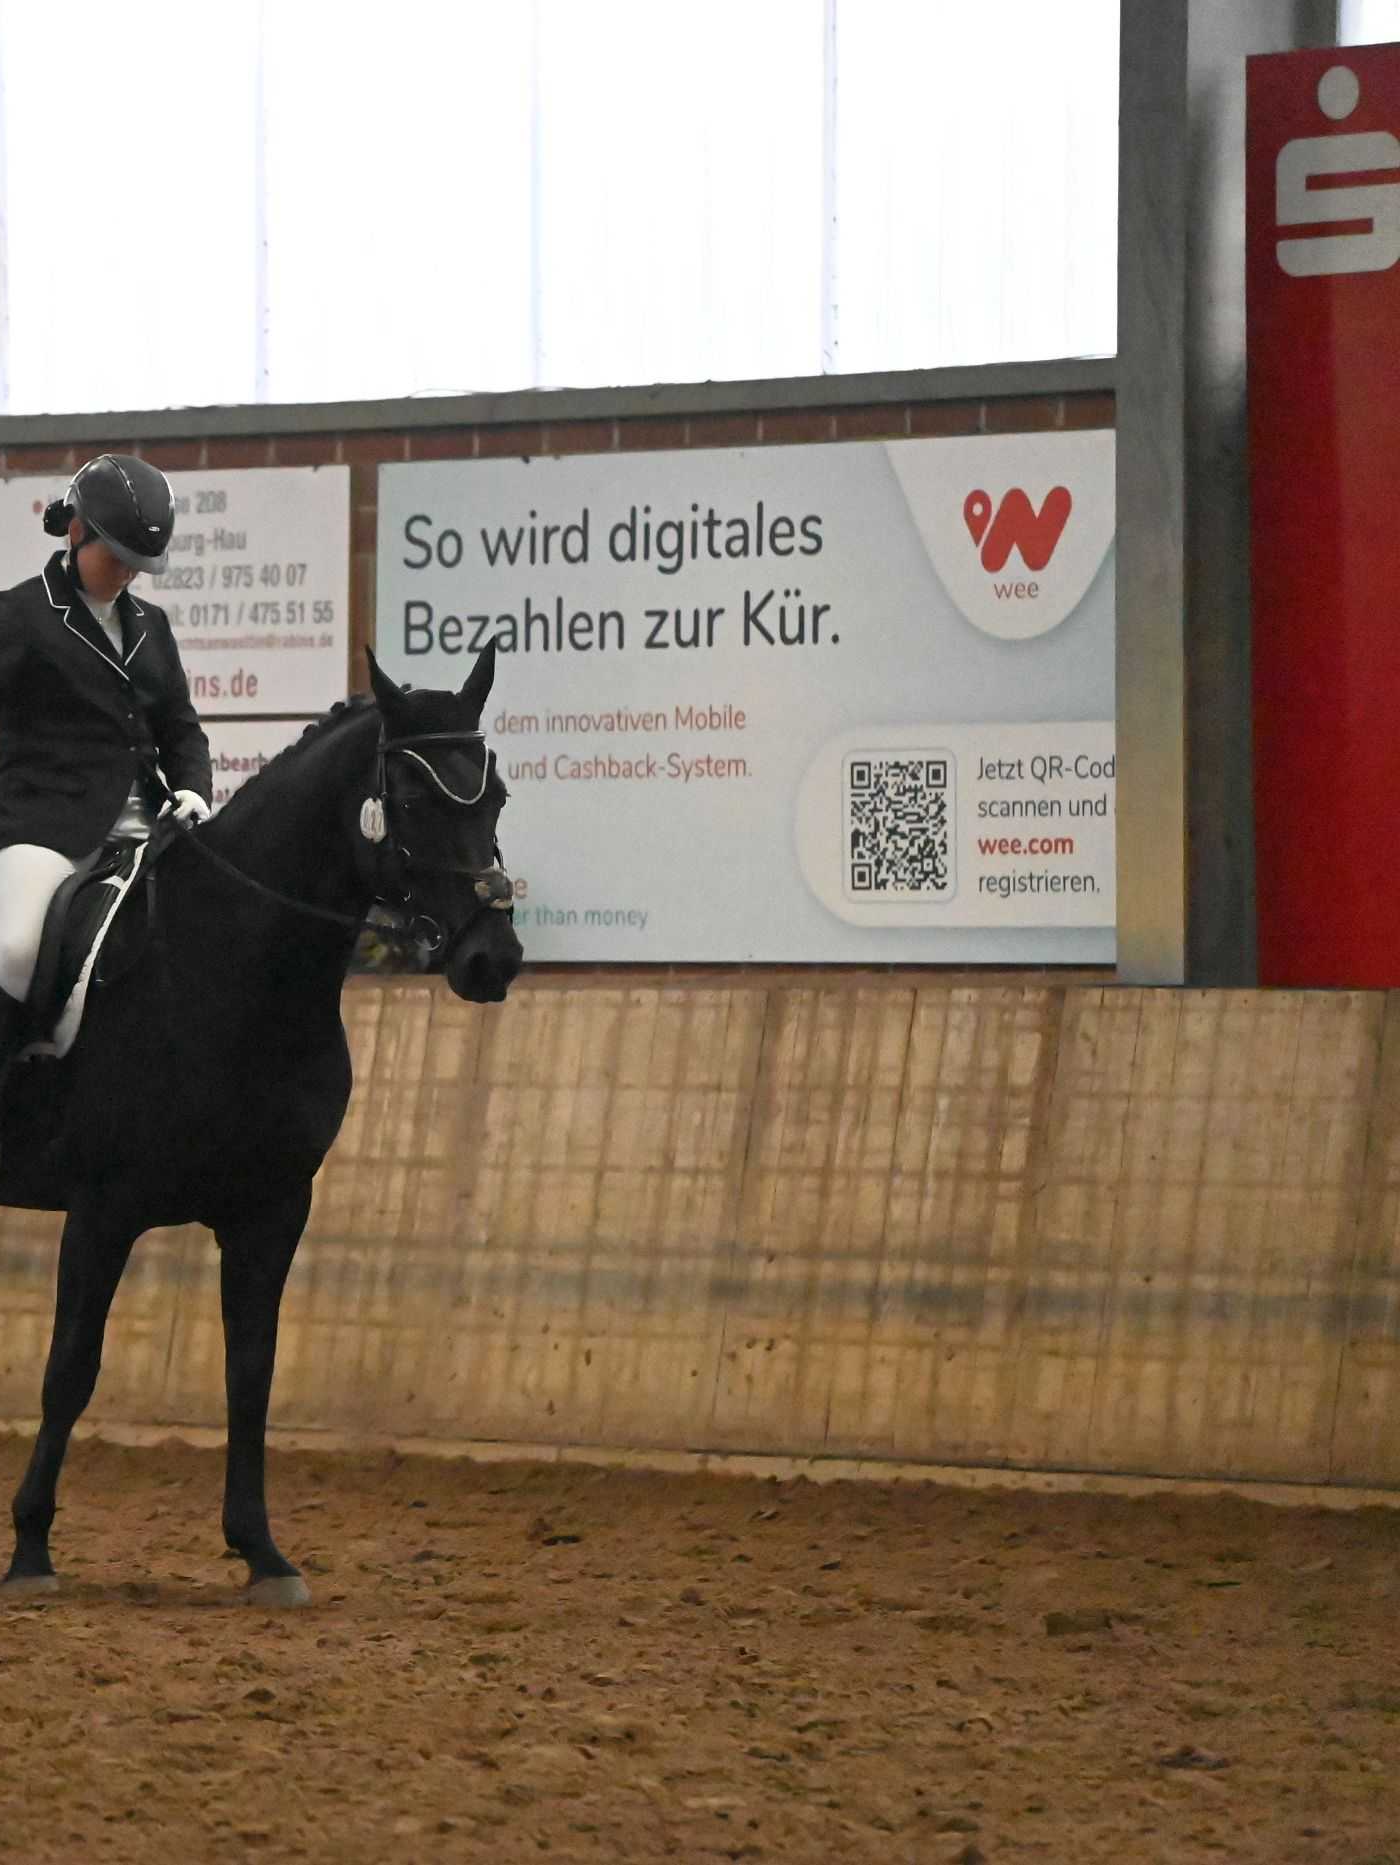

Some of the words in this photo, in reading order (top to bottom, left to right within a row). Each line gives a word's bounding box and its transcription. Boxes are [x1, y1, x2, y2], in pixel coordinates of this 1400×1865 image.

[403, 514, 463, 569] So
[481, 508, 589, 567] wird
[608, 501, 823, 575] digitales
[221, 565, 254, 590] 975
[260, 563, 281, 588] 40
[286, 562, 308, 586] 07
[993, 581, 1039, 599] wee
[189, 604, 230, 628] 0171
[249, 602, 281, 626] 475
[286, 602, 306, 624] 51
[312, 601, 334, 624] 55
[403, 597, 625, 656] Bezahlen
[644, 606, 726, 649] zur
[743, 588, 841, 647] Kür.
[494, 709, 540, 736] dem
[546, 705, 667, 735] innovativen
[674, 704, 747, 732] Mobile
[507, 754, 548, 781] und
[553, 751, 752, 783] Cashback-System.
[977, 757, 1025, 781] Jetzt
[977, 798, 1063, 818] scannen
[1068, 793, 1108, 817] und
[977, 837, 1074, 856] wee.com
[978, 870, 1101, 898] registrieren.
[535, 902, 578, 926] than
[584, 907, 649, 930] money
